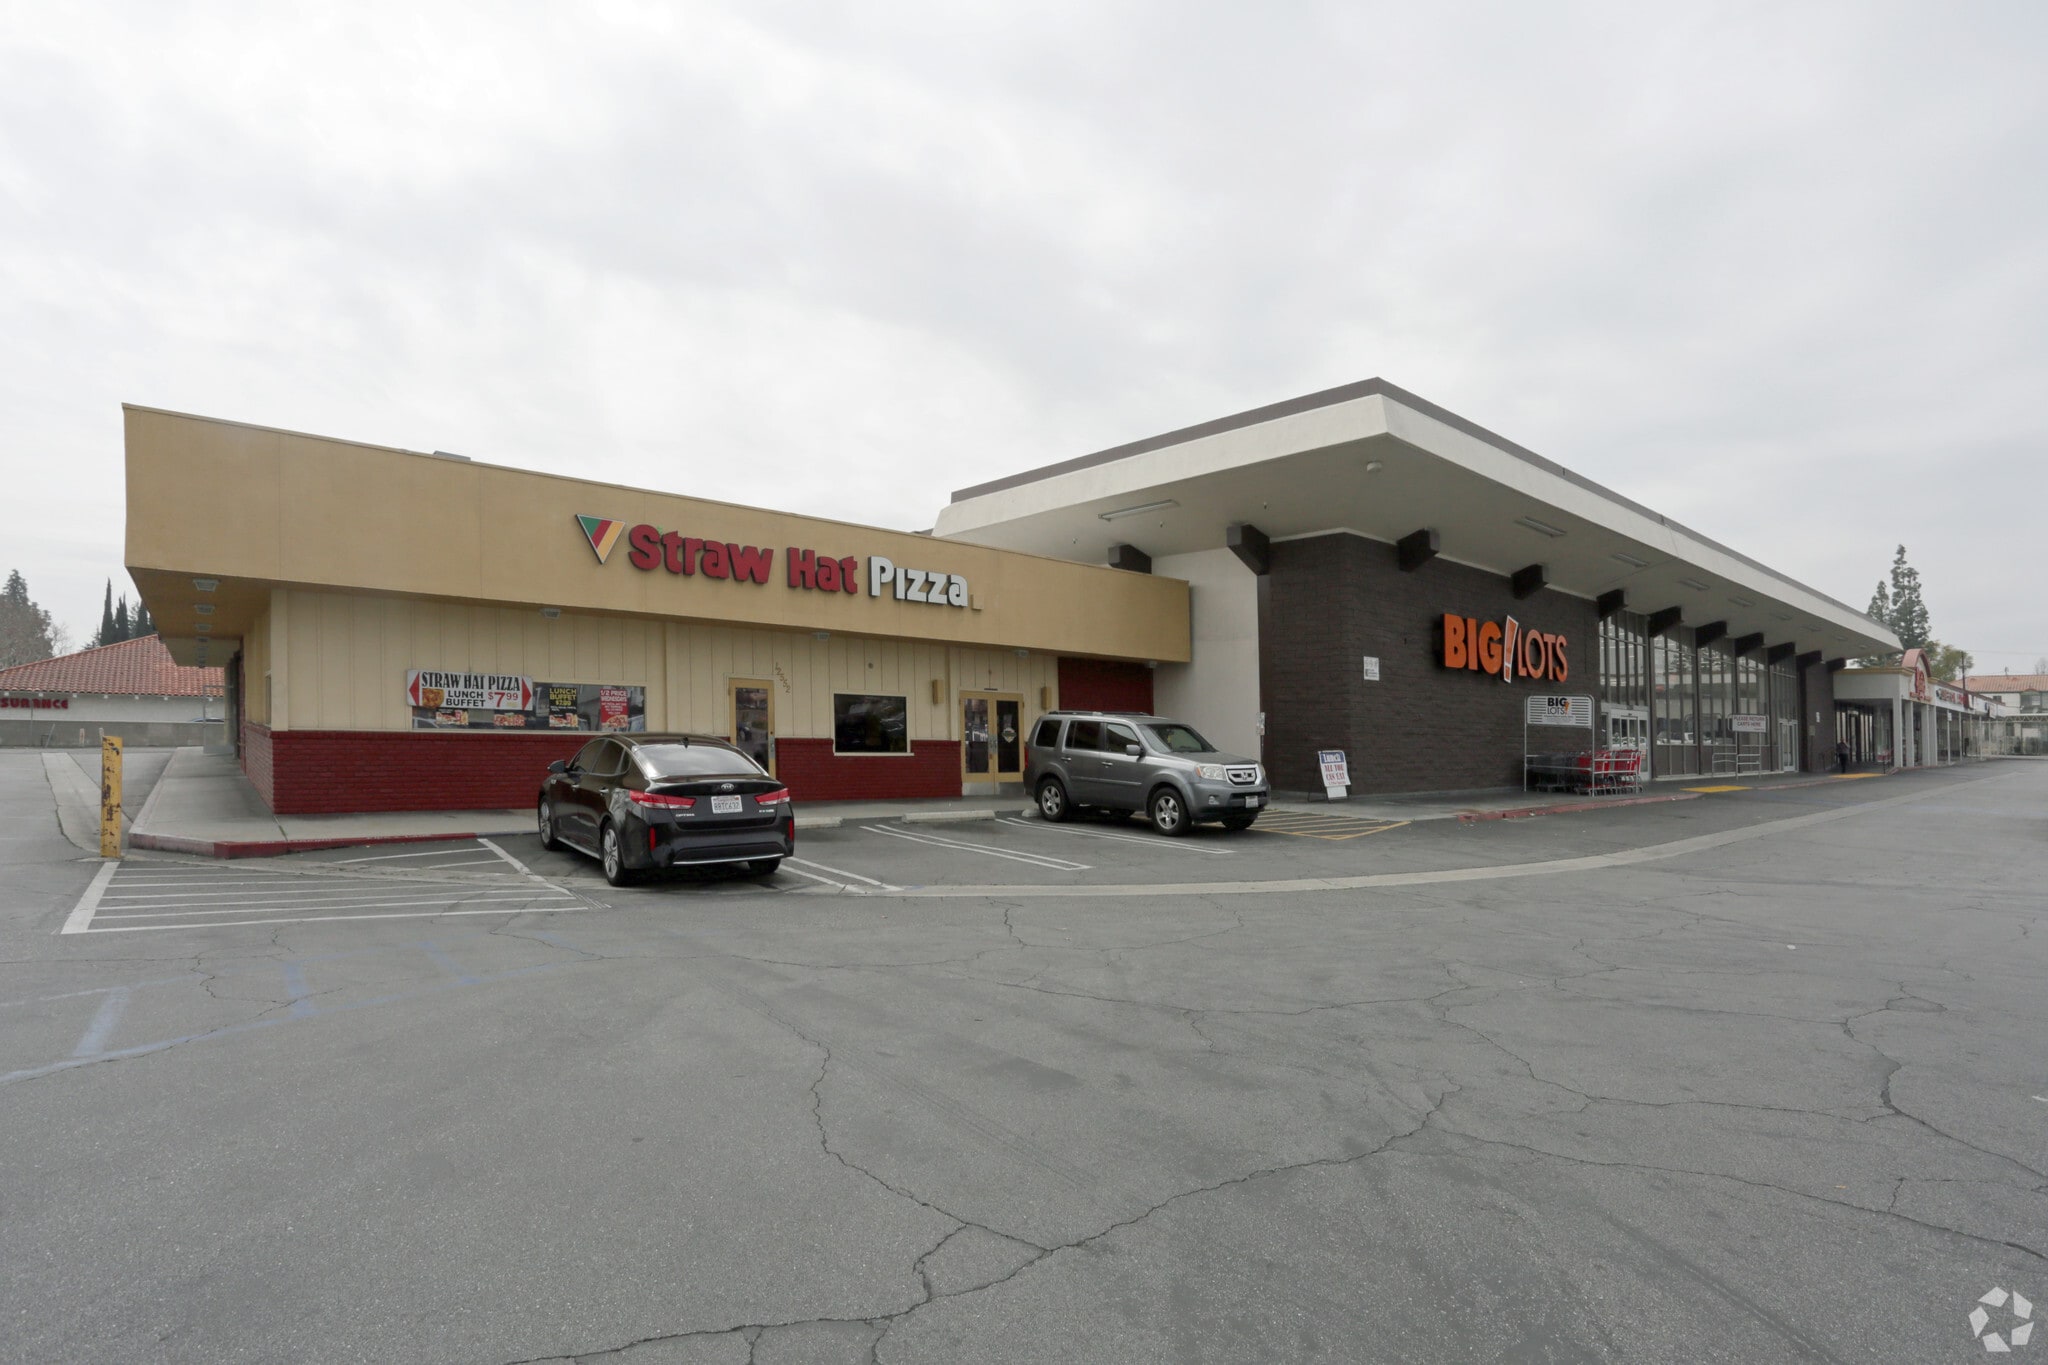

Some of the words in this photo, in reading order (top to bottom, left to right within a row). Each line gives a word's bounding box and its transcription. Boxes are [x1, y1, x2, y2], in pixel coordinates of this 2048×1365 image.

[628, 523, 775, 586] Straw
[786, 546, 860, 595] Hat
[867, 555, 969, 609] Pizza
[421, 671, 461, 689] STRAW
[464, 674, 485, 690] HAT
[488, 675, 521, 692] PIZZA
[447, 690, 484, 699] LUNCH
[446, 698, 486, 707] BUFFET
[1547, 697, 1568, 707] BIG
